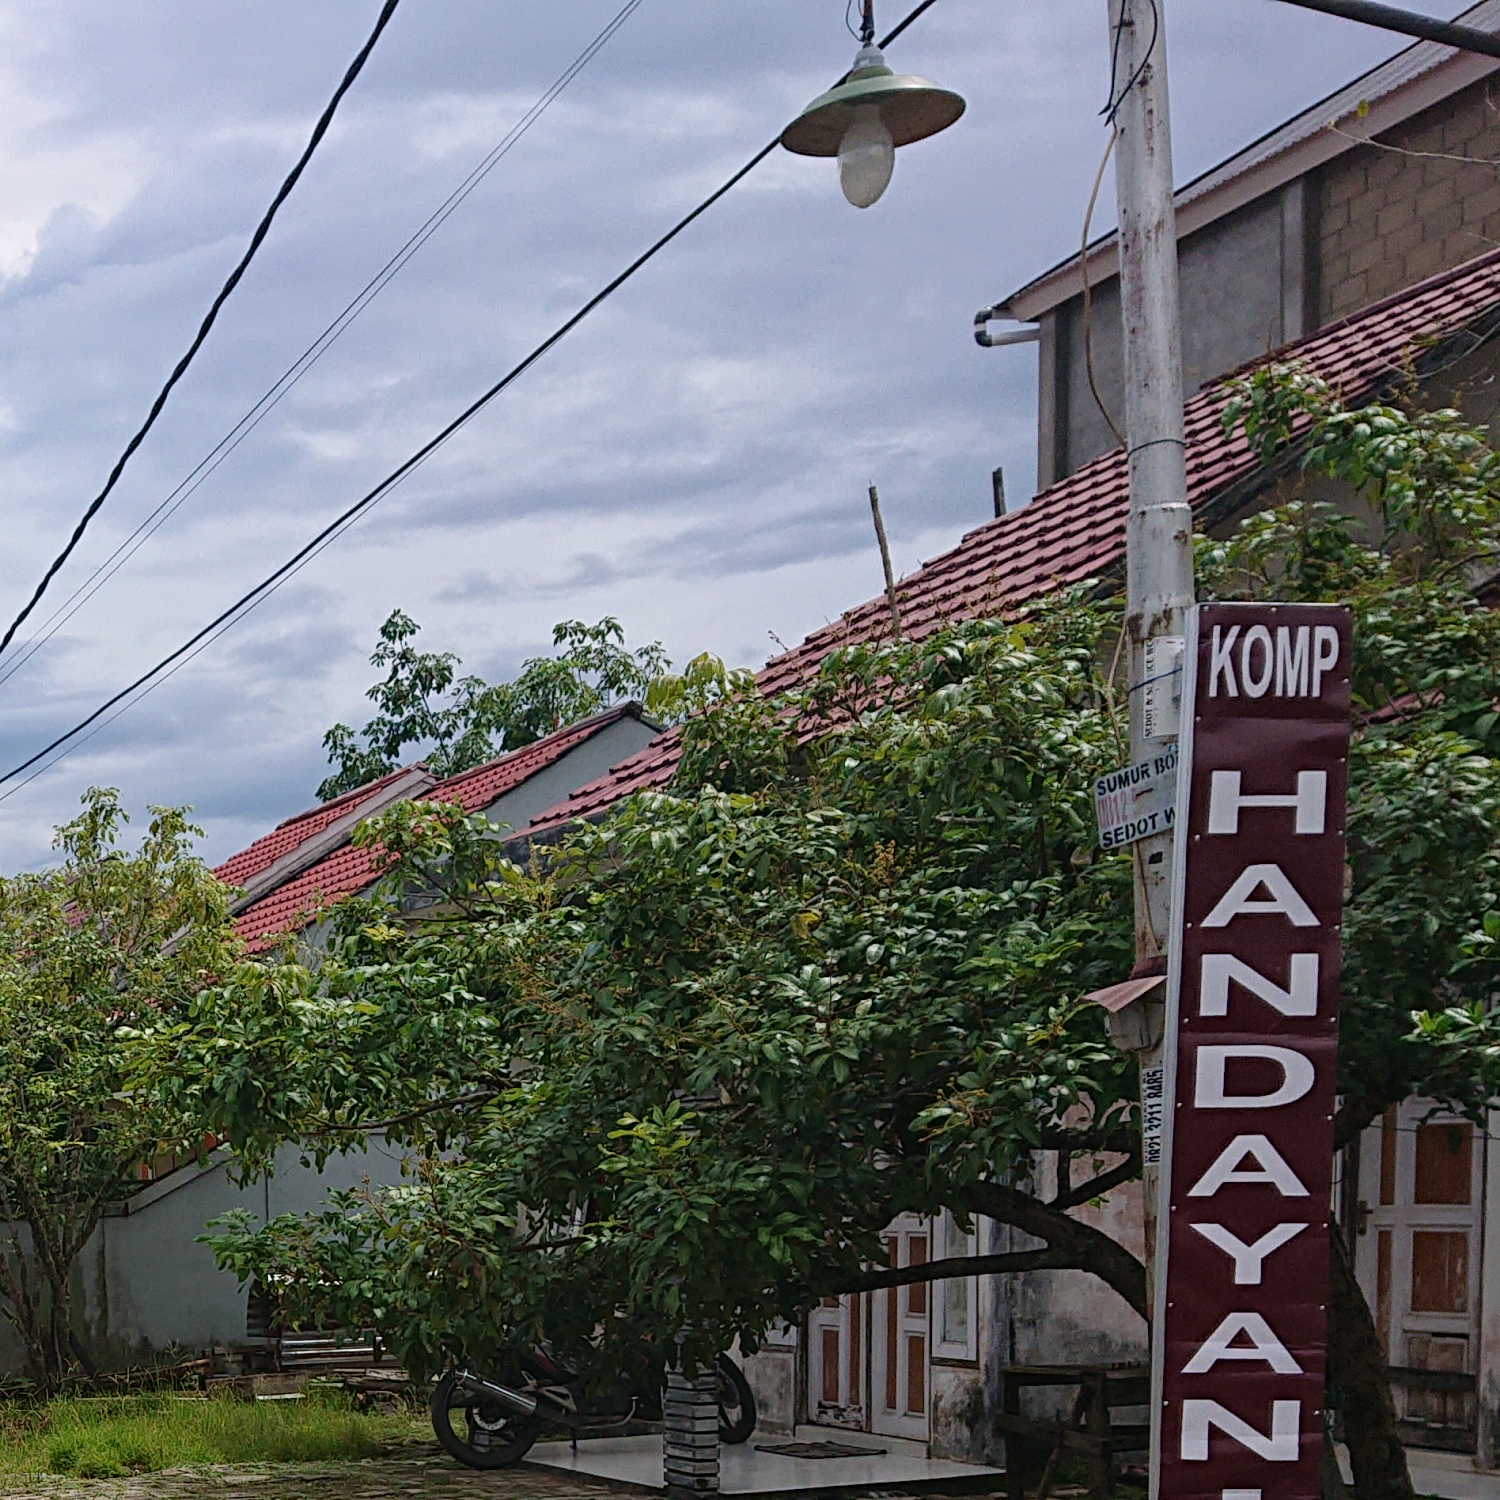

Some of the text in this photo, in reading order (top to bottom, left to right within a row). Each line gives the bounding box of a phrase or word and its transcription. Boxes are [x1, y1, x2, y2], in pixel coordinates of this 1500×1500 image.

[1208, 623, 1340, 698] KOMP
[1097, 763, 1151, 796] SUMUR
[1154, 753, 1179, 775] BO
[1102, 812, 1159, 848] SEDOT
